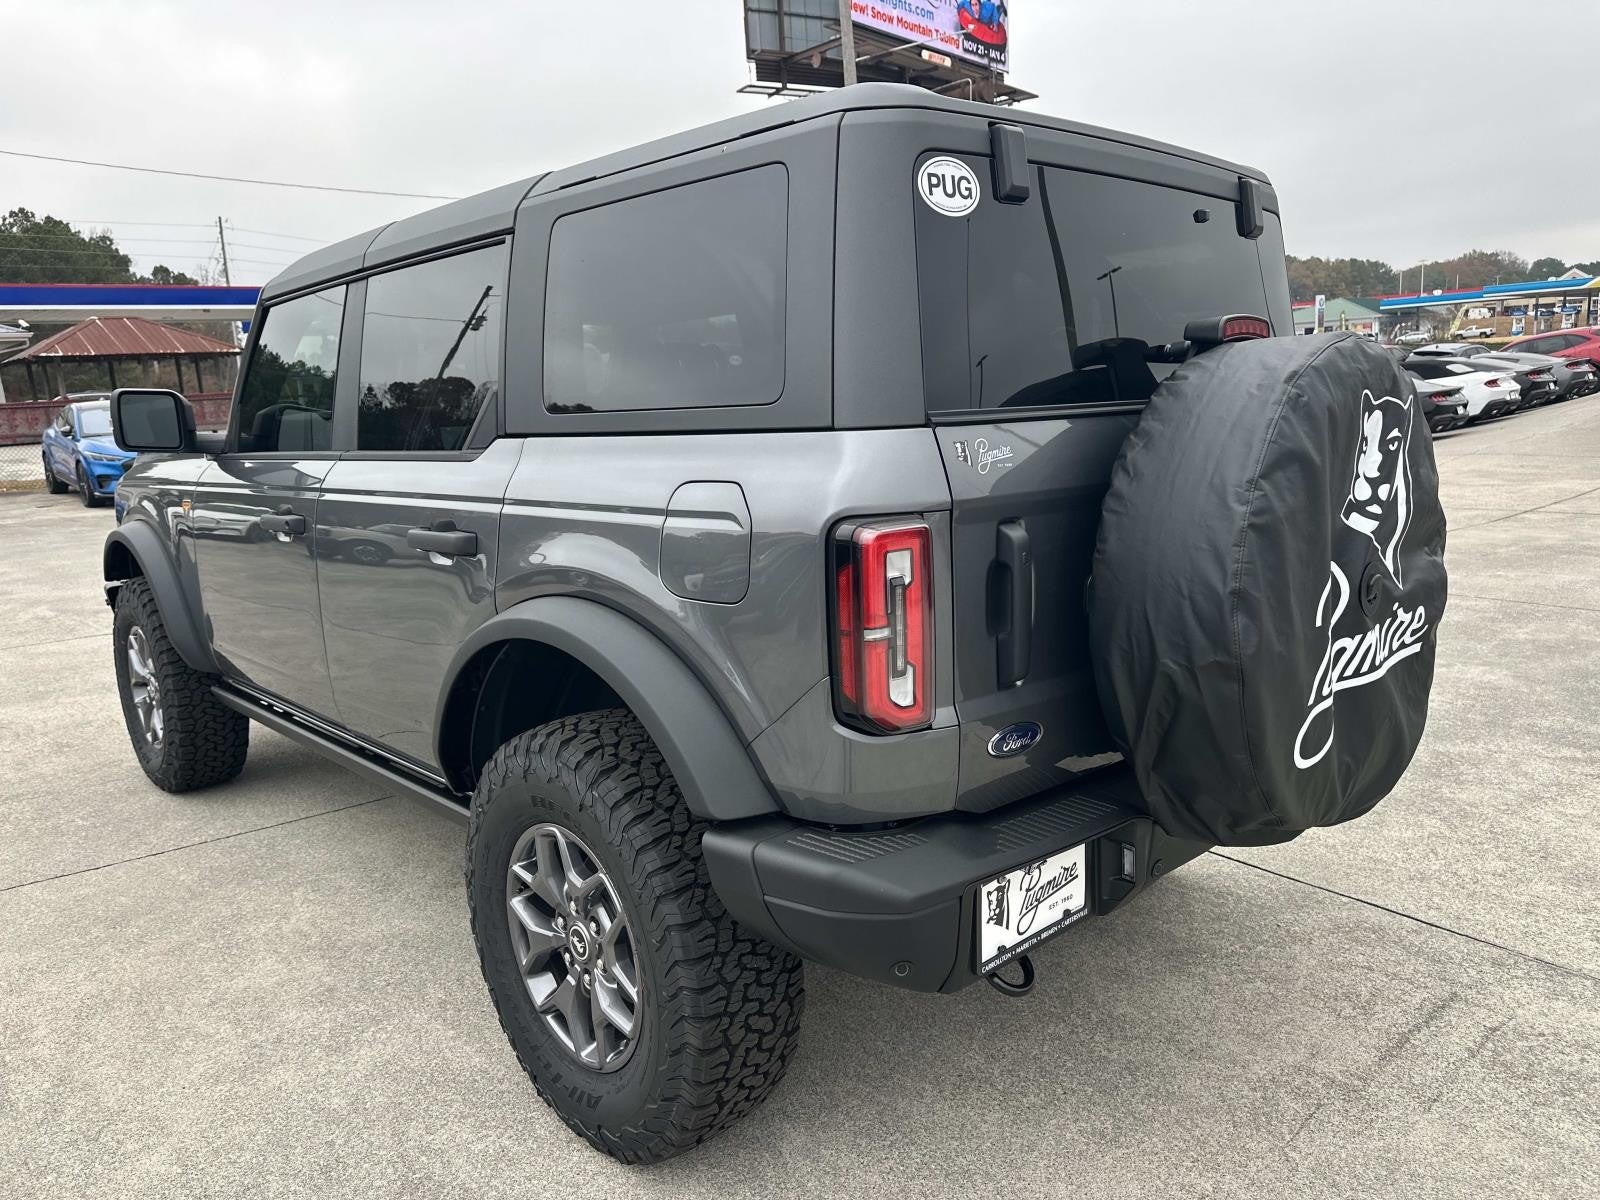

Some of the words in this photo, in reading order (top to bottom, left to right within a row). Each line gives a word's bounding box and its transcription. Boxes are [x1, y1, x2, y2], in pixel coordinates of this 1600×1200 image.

[871, 6, 895, 25] Snow
[896, 15, 933, 38] Mountain
[934, 28, 960, 49] Tubing
[963, 39, 978, 53] NOV
[977, 45, 985, 55] 21
[926, 172, 973, 200] PUG
[975, 438, 1013, 474] Pugmire
[1003, 731, 1032, 752] Ford
[1017, 861, 1079, 935] Pugmire
